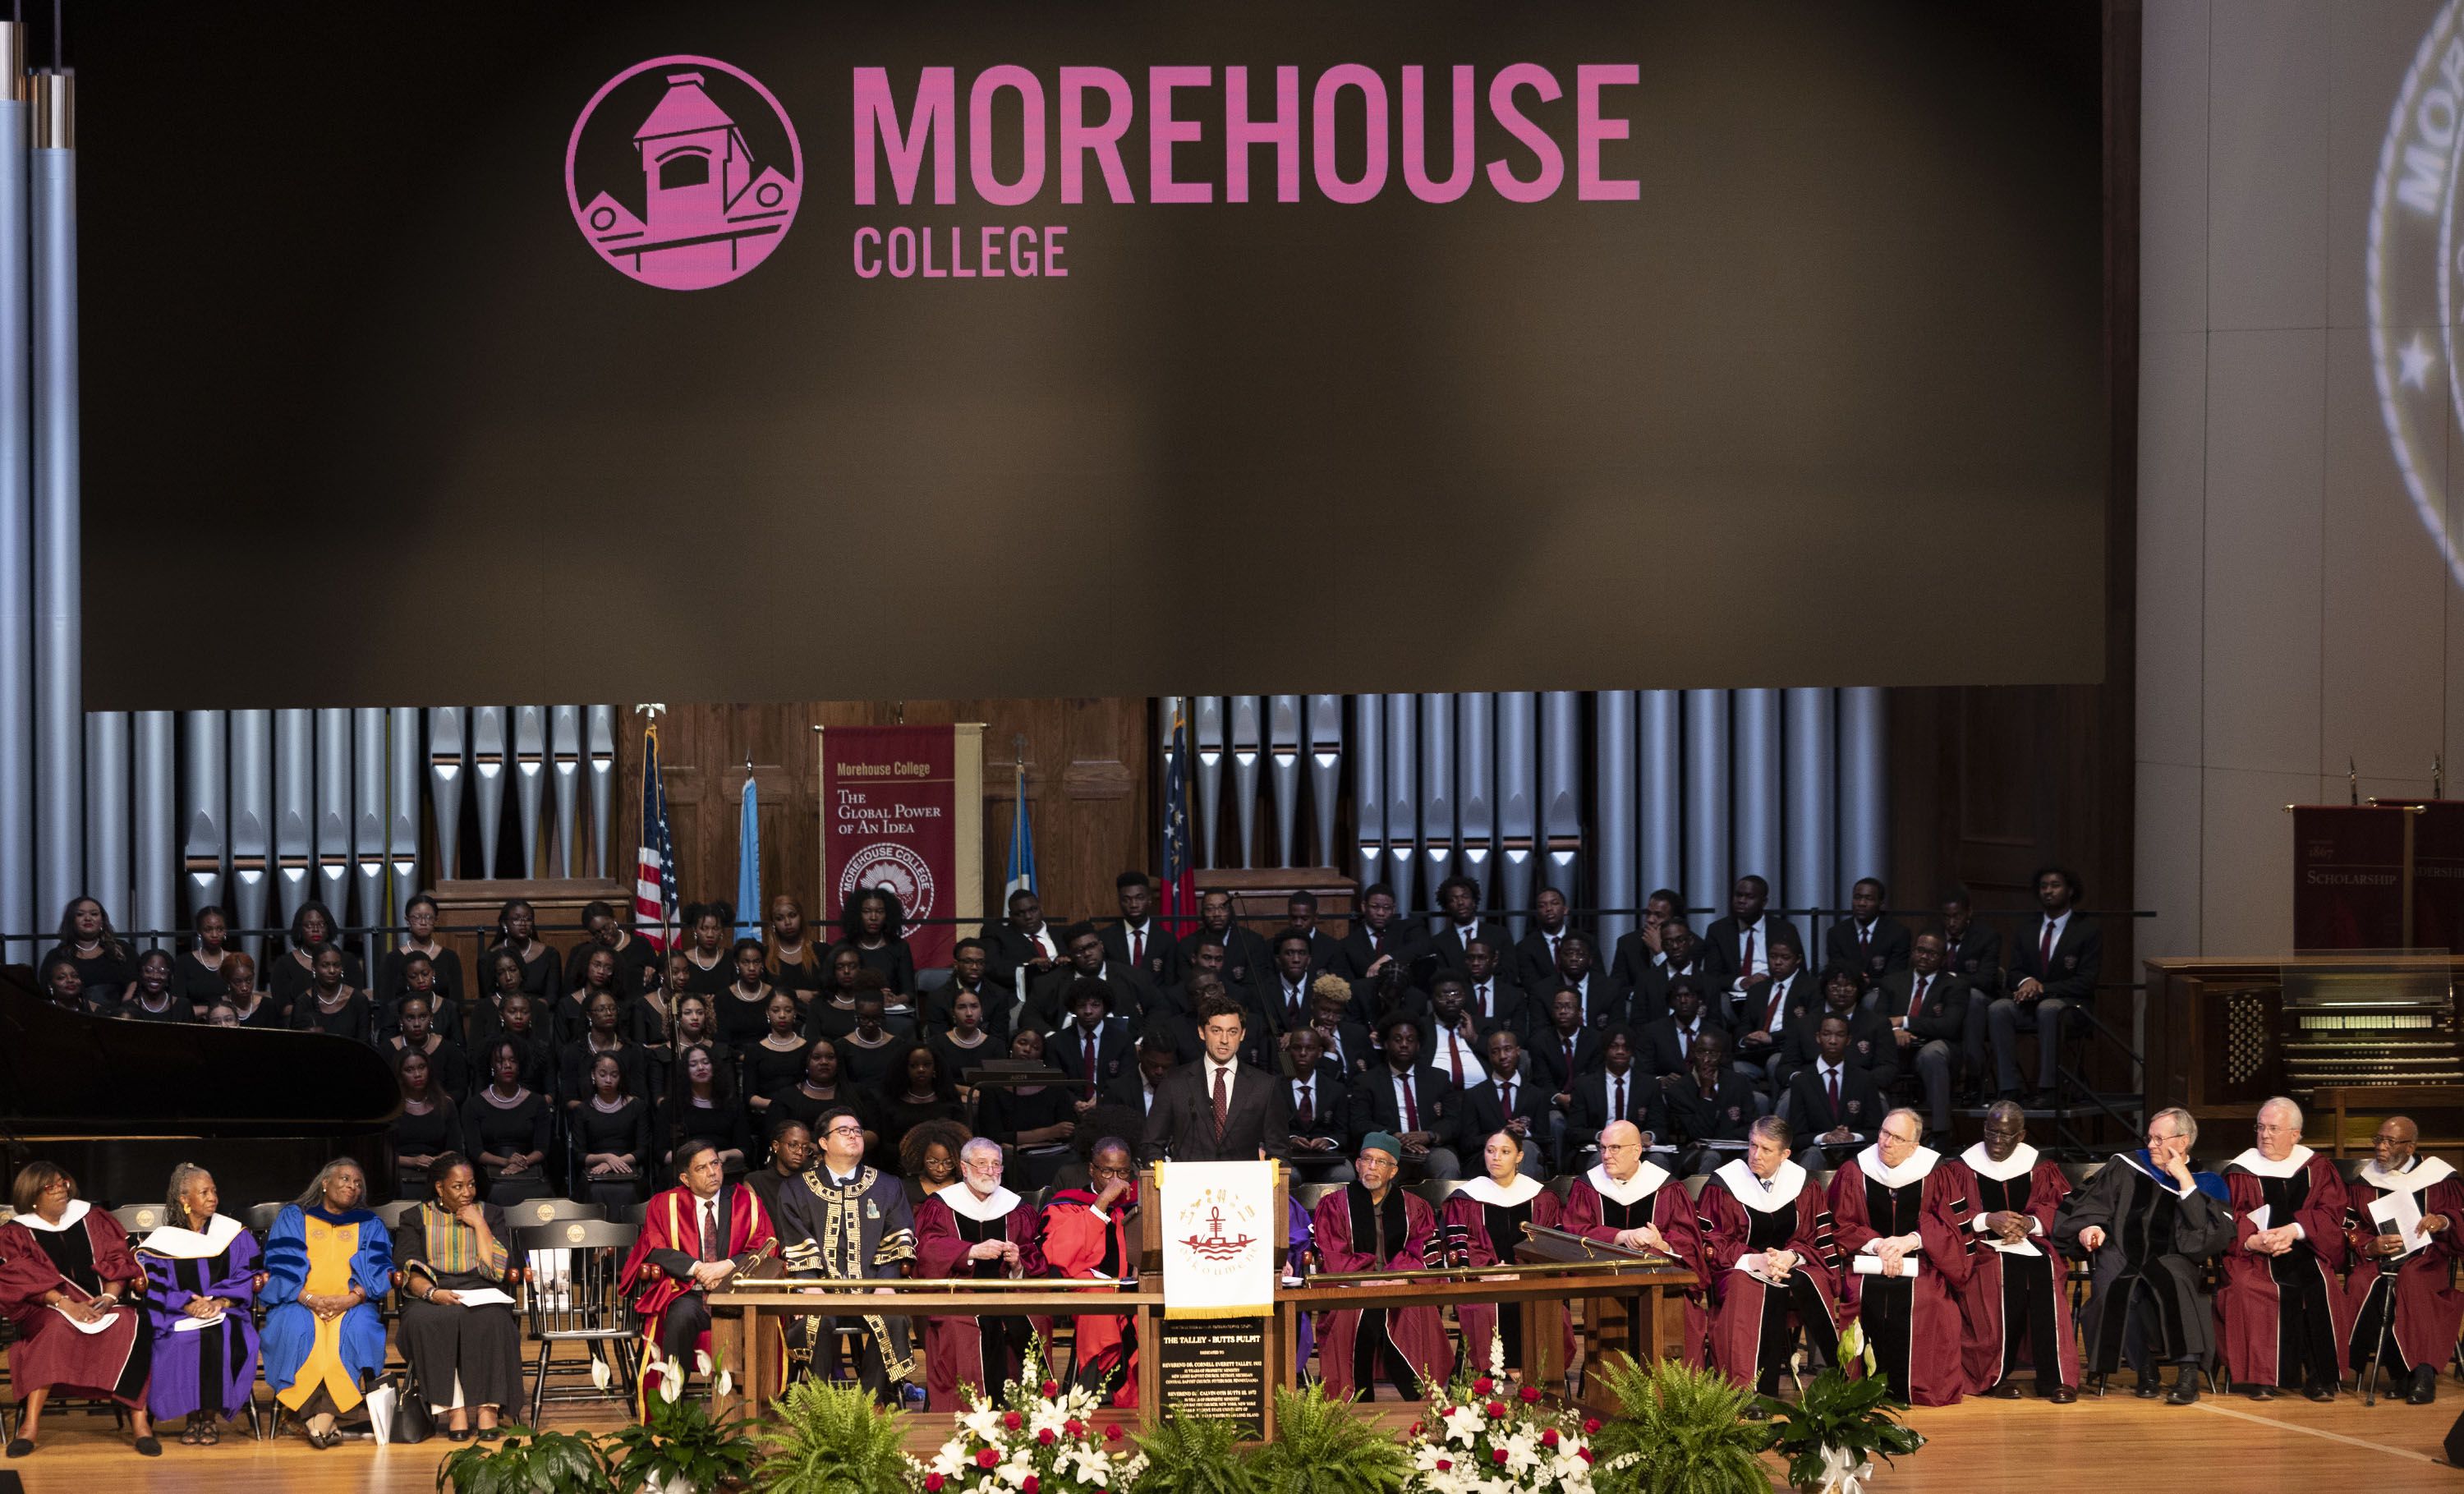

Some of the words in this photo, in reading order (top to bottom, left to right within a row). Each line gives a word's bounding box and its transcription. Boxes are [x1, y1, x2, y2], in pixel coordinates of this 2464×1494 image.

[853, 62, 1639, 205] MOREHOUSE
[853, 225, 1068, 279] COLLEGE
[837, 762, 891, 776] Morehouse
[894, 761, 931, 776] College
[844, 846, 893, 892] MOREHOUSE
[895, 849, 931, 890] COLLEGE
[1179, 1335, 1207, 1344] TALLEY
[1235, 1335, 1261, 1343] PULPIT
